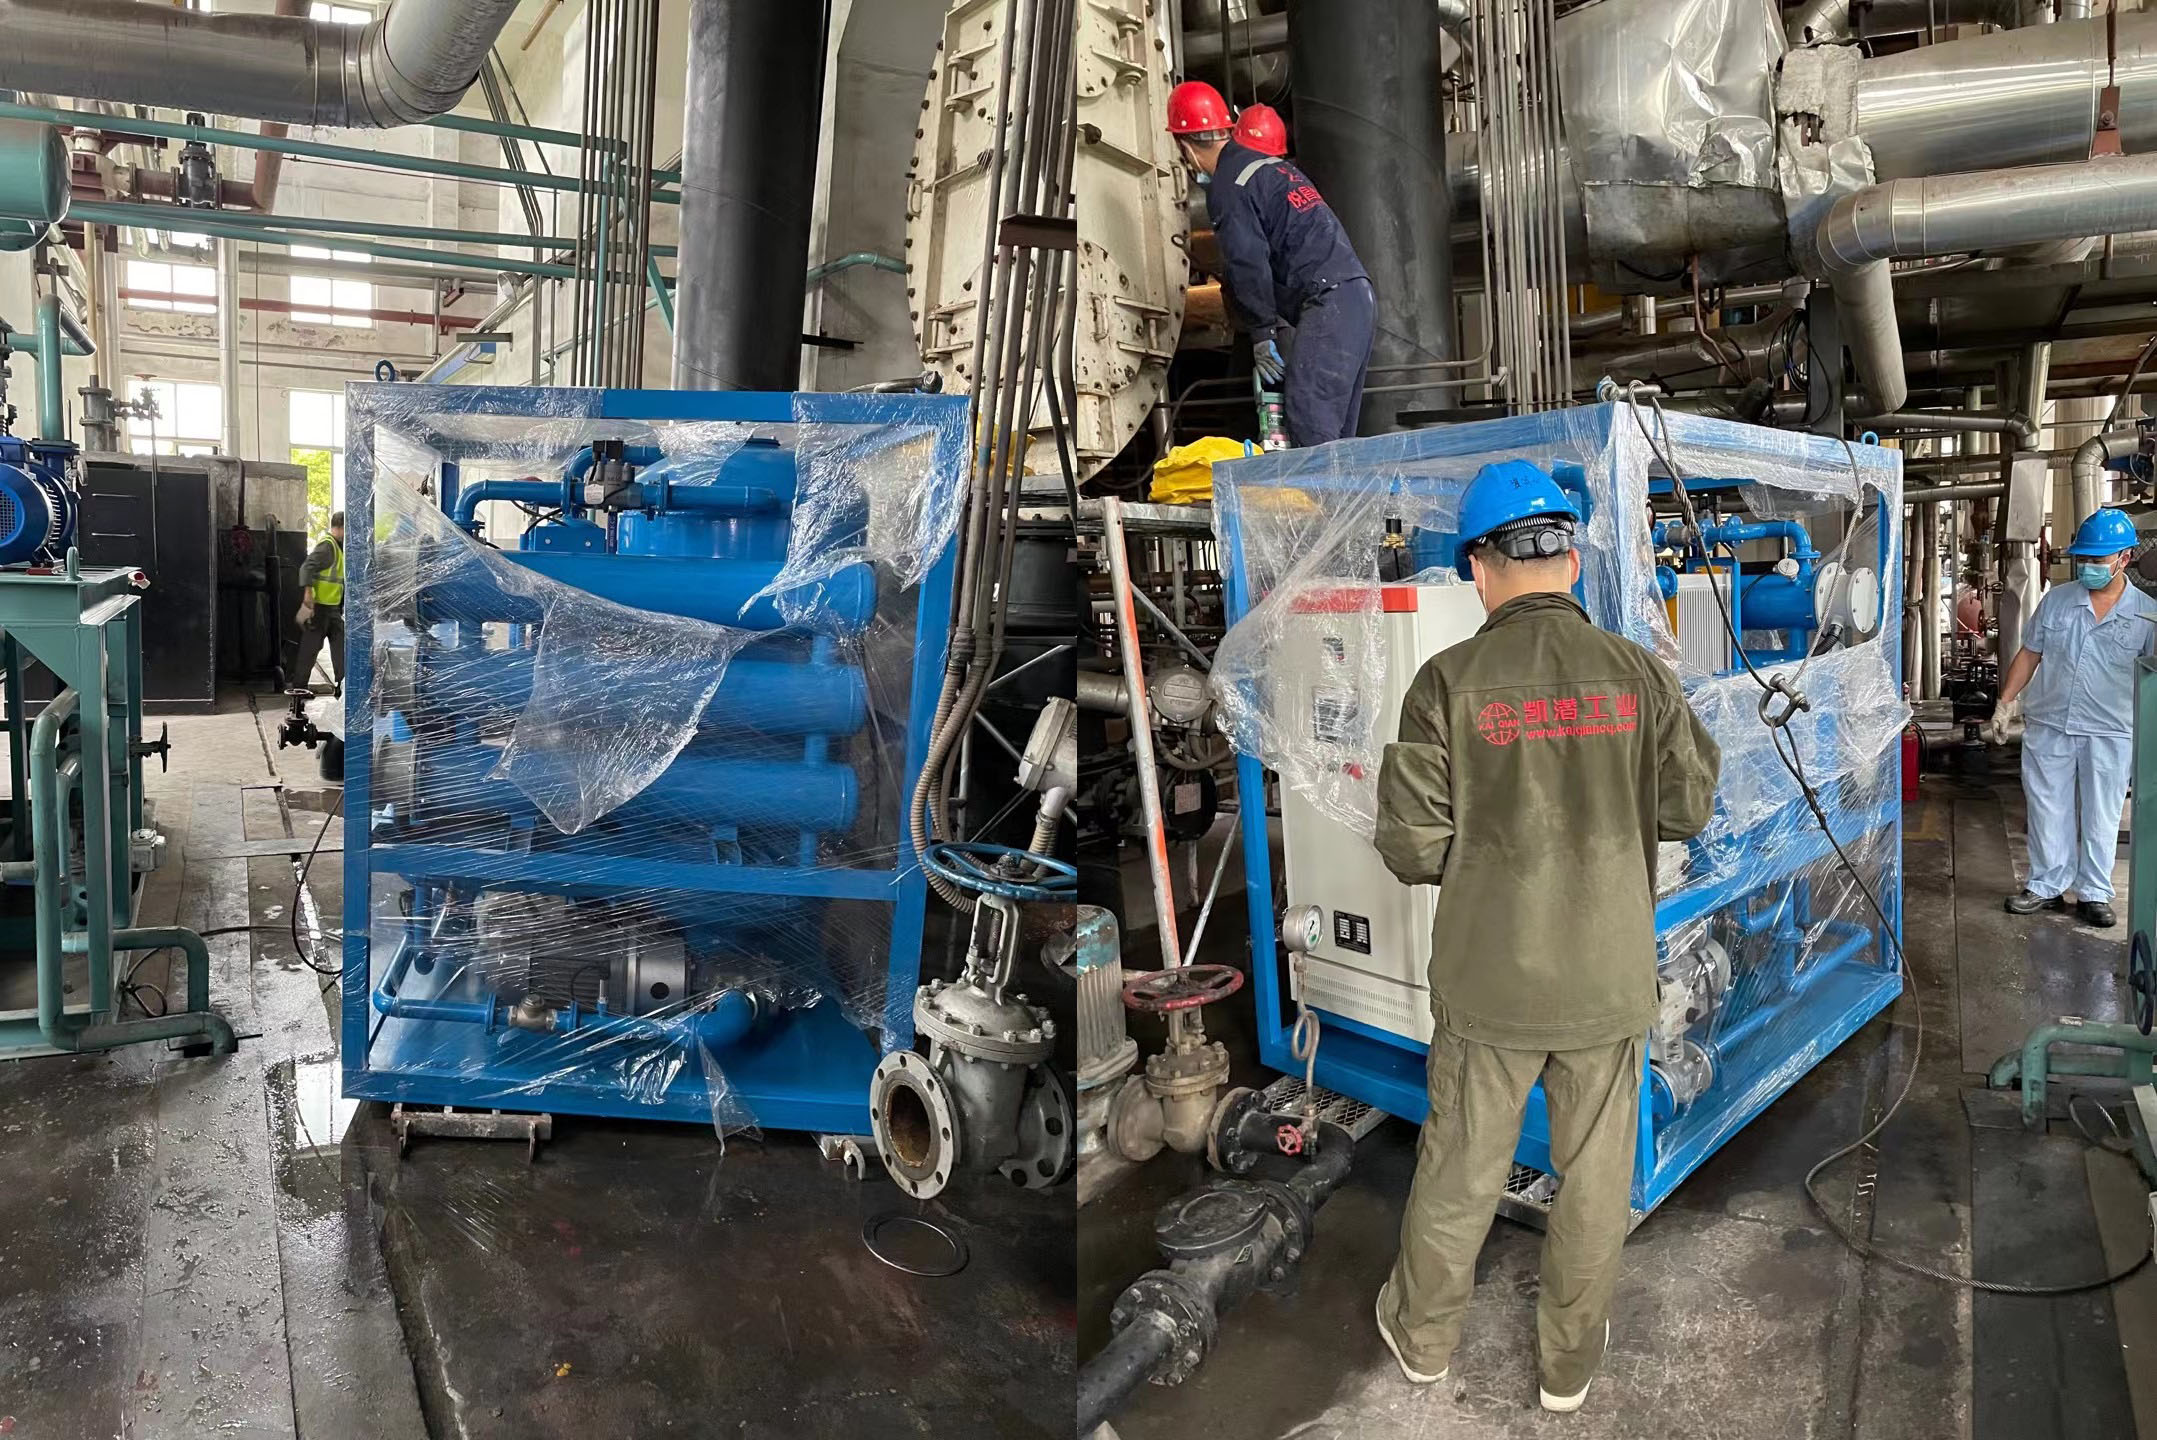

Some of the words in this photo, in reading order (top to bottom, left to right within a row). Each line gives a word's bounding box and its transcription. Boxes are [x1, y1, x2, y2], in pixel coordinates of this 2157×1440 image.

[1524, 693, 1637, 723] 凯潜工业
[1478, 721, 1495, 731] KAI
[1498, 719, 1521, 729] QIAN
